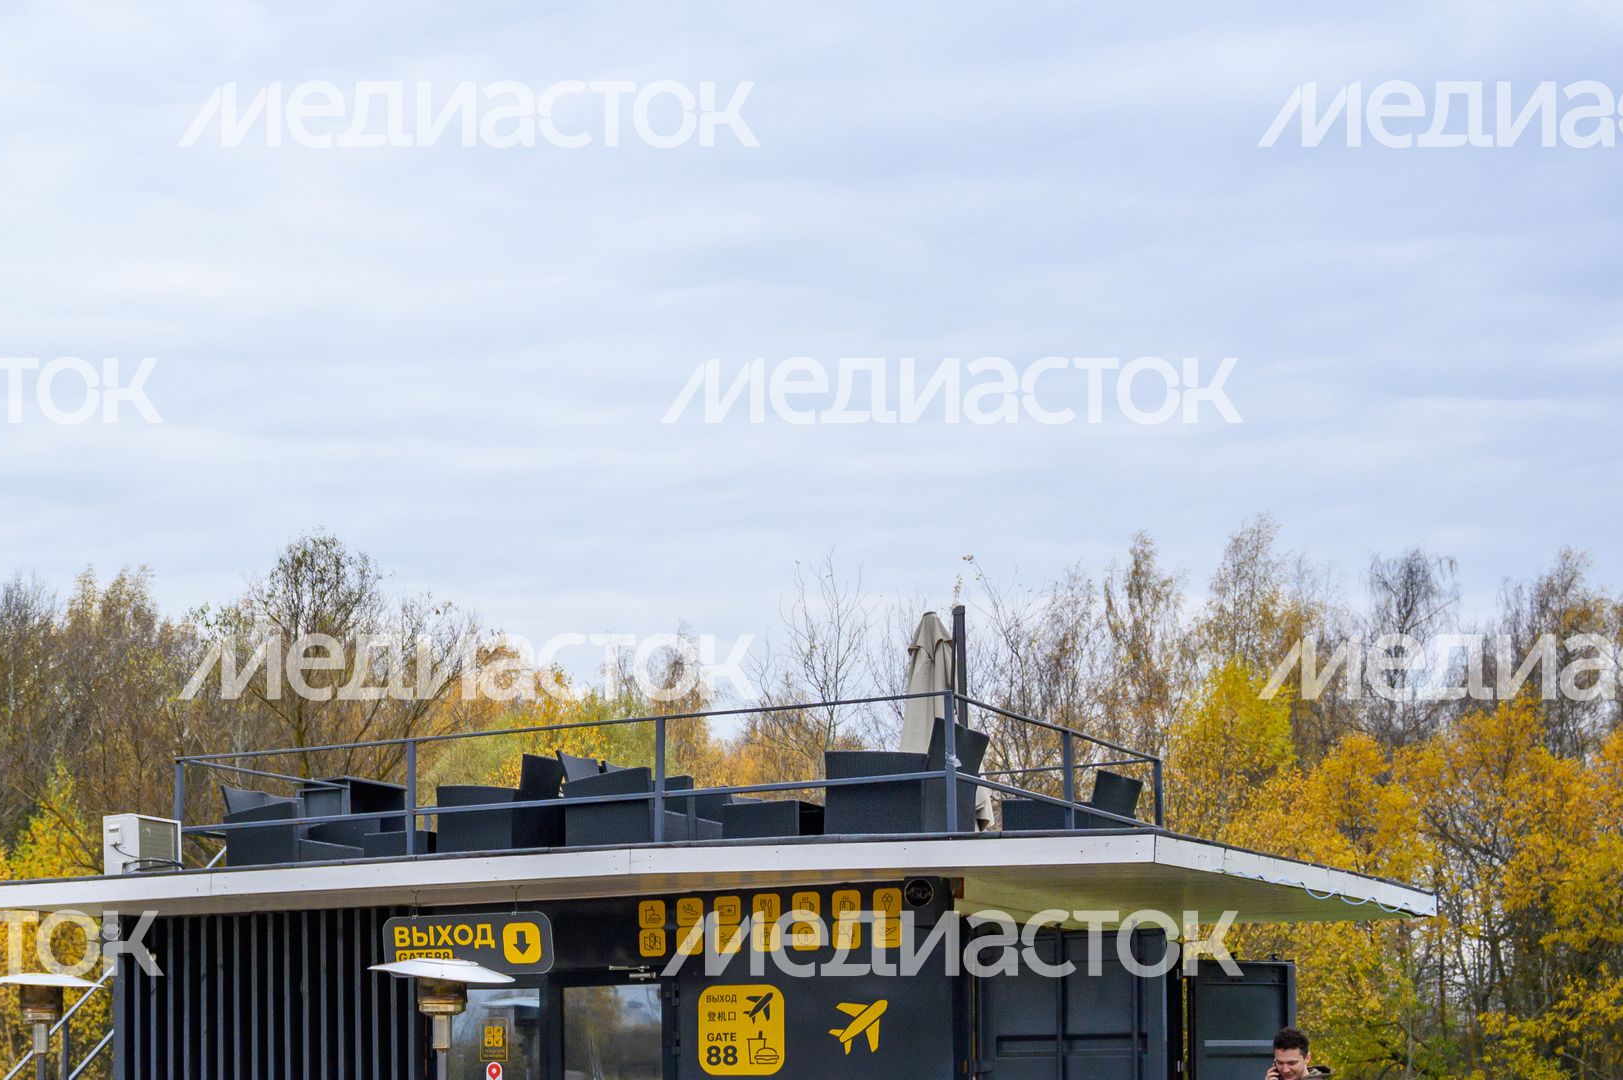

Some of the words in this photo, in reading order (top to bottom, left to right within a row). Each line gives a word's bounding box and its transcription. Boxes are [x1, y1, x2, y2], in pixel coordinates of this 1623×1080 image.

[394, 924, 495, 949] ВЫХОД
[706, 994, 737, 1004] ВЫХОД
[707, 1011, 736, 1022] 登机口
[707, 1032, 737, 1042] GATE
[706, 1045, 738, 1066] 88
